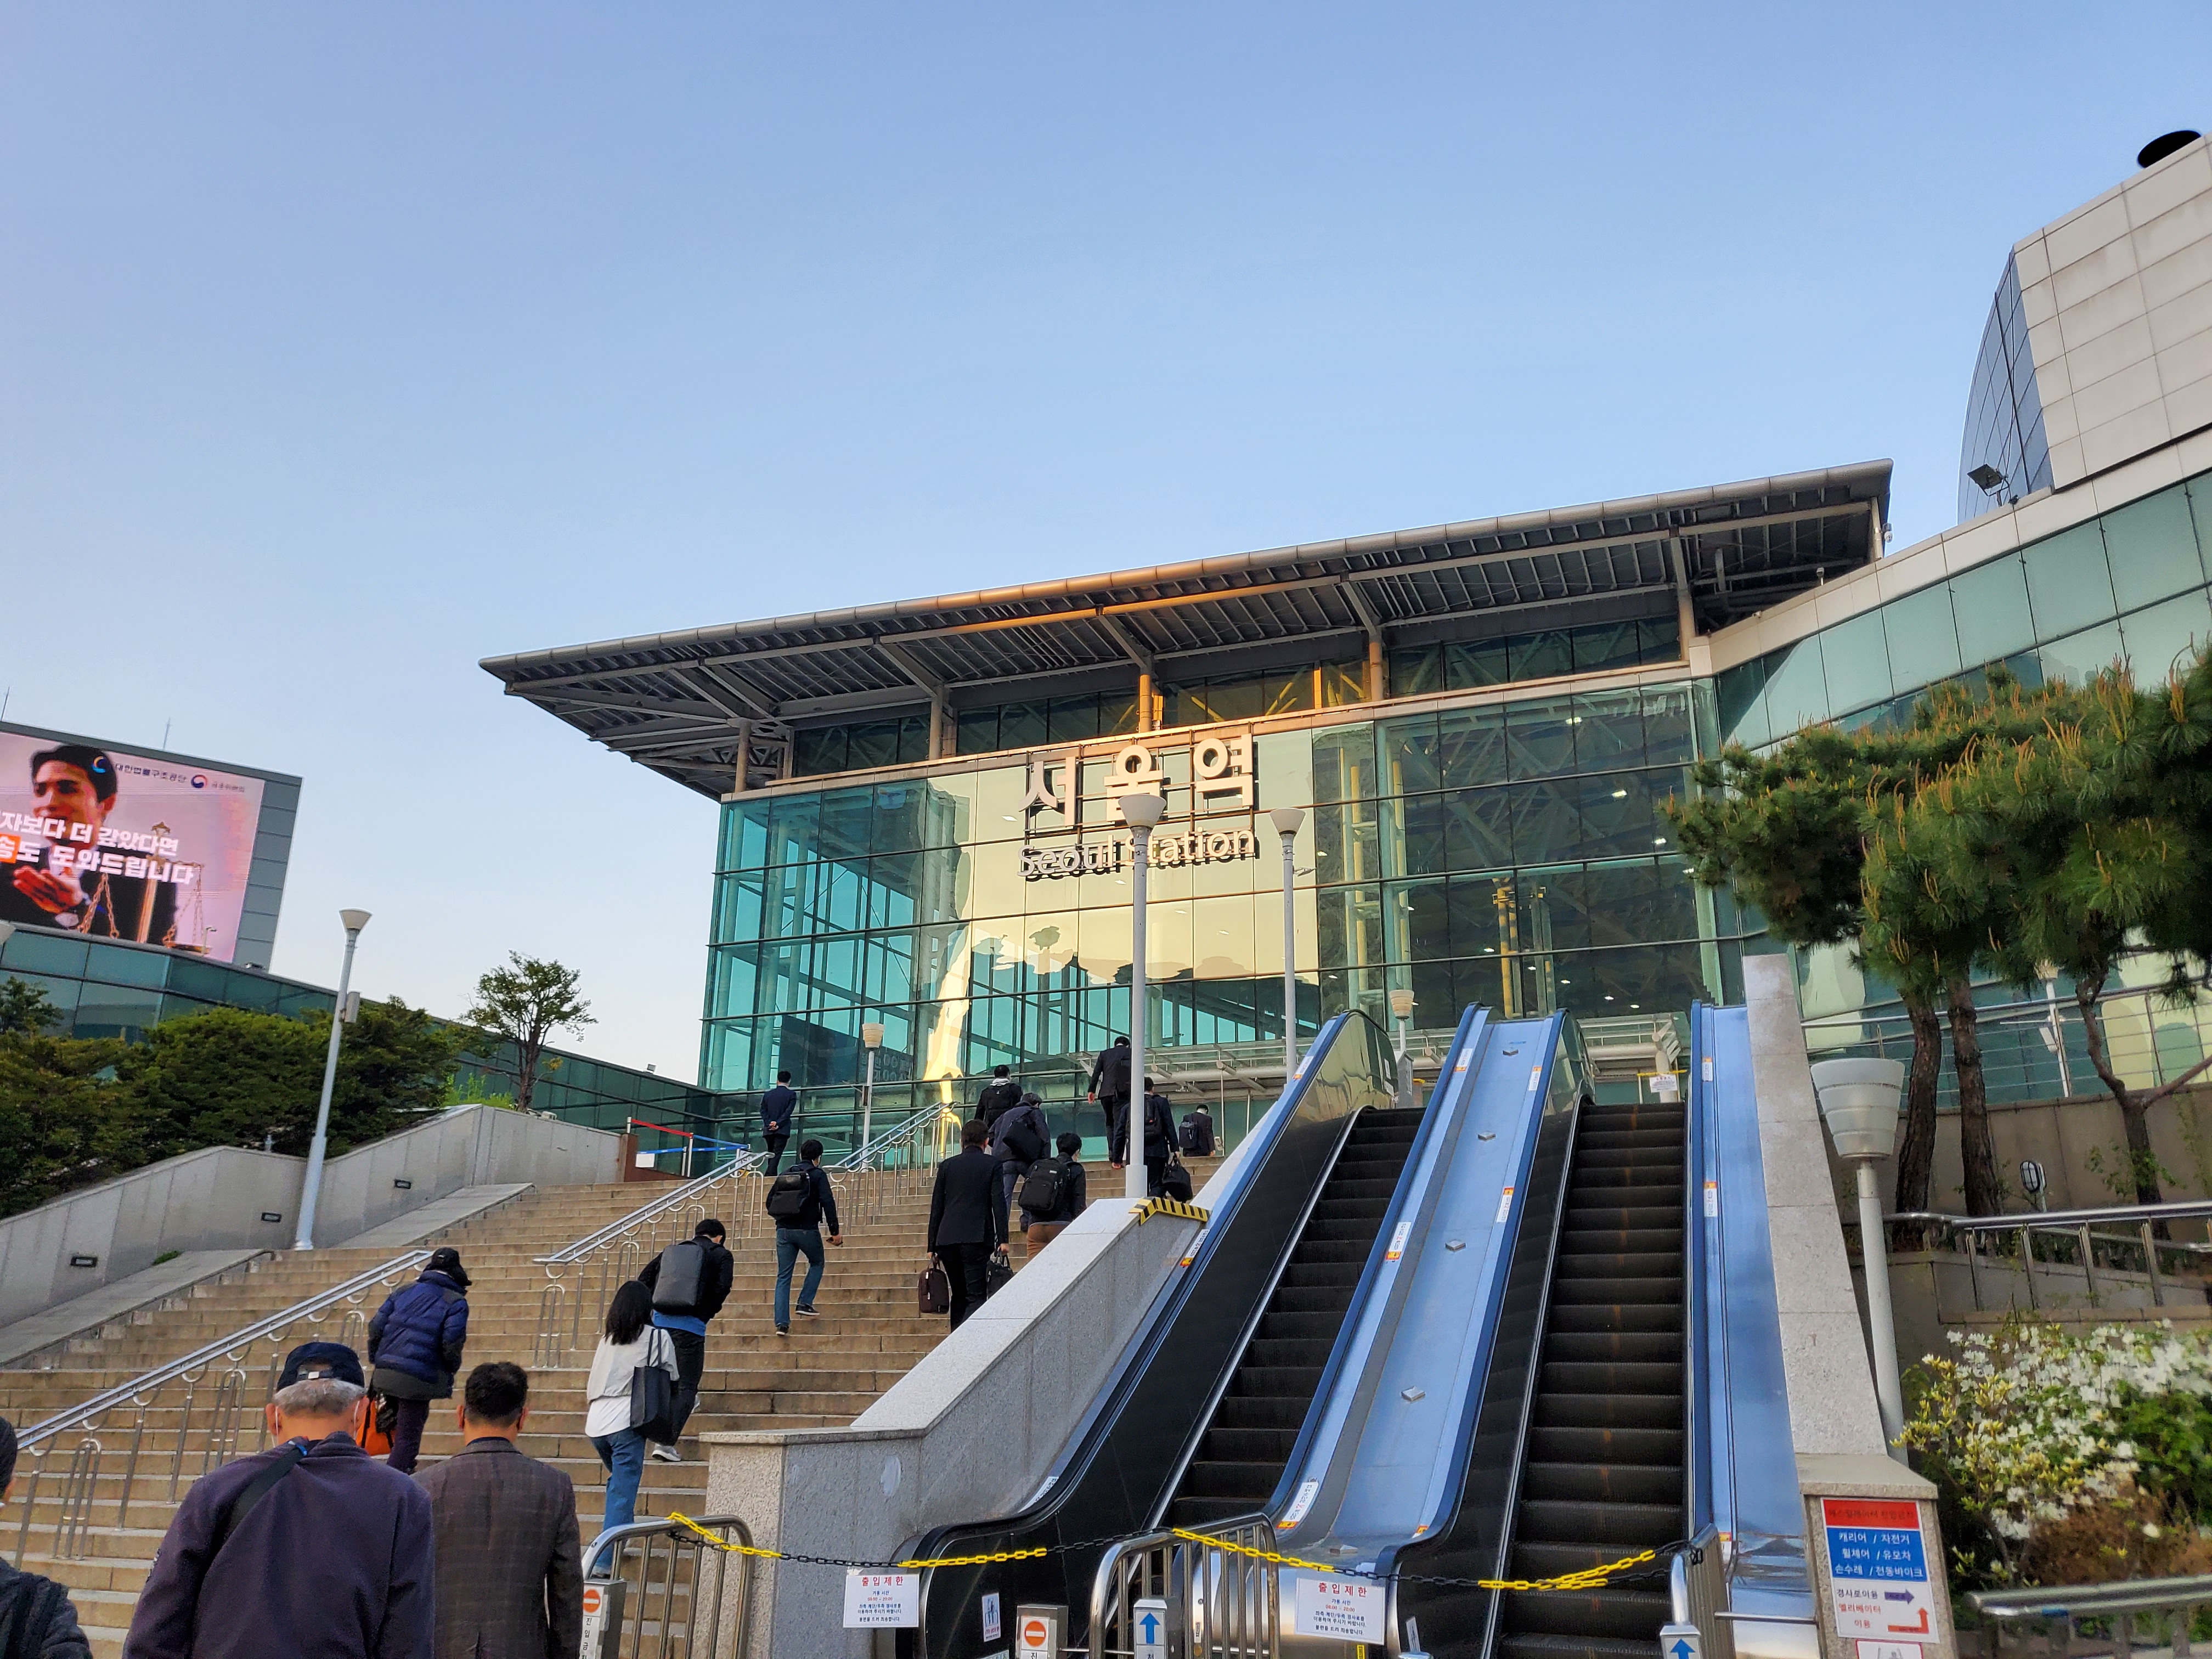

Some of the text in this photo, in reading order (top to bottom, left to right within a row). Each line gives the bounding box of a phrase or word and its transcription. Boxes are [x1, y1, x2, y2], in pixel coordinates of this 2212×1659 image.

[1018, 733, 1254, 826] 서울역
[70, 822, 93, 844] 더
[97, 826, 179, 857] 갚았다면
[1017, 834, 1114, 877] Seoul
[51, 845, 194, 884] 도와드립니다
[1839, 1531, 1866, 1543] 캐리어
[1882, 1532, 1910, 1545] 자전거
[1835, 1563, 1863, 1575] 손수레
